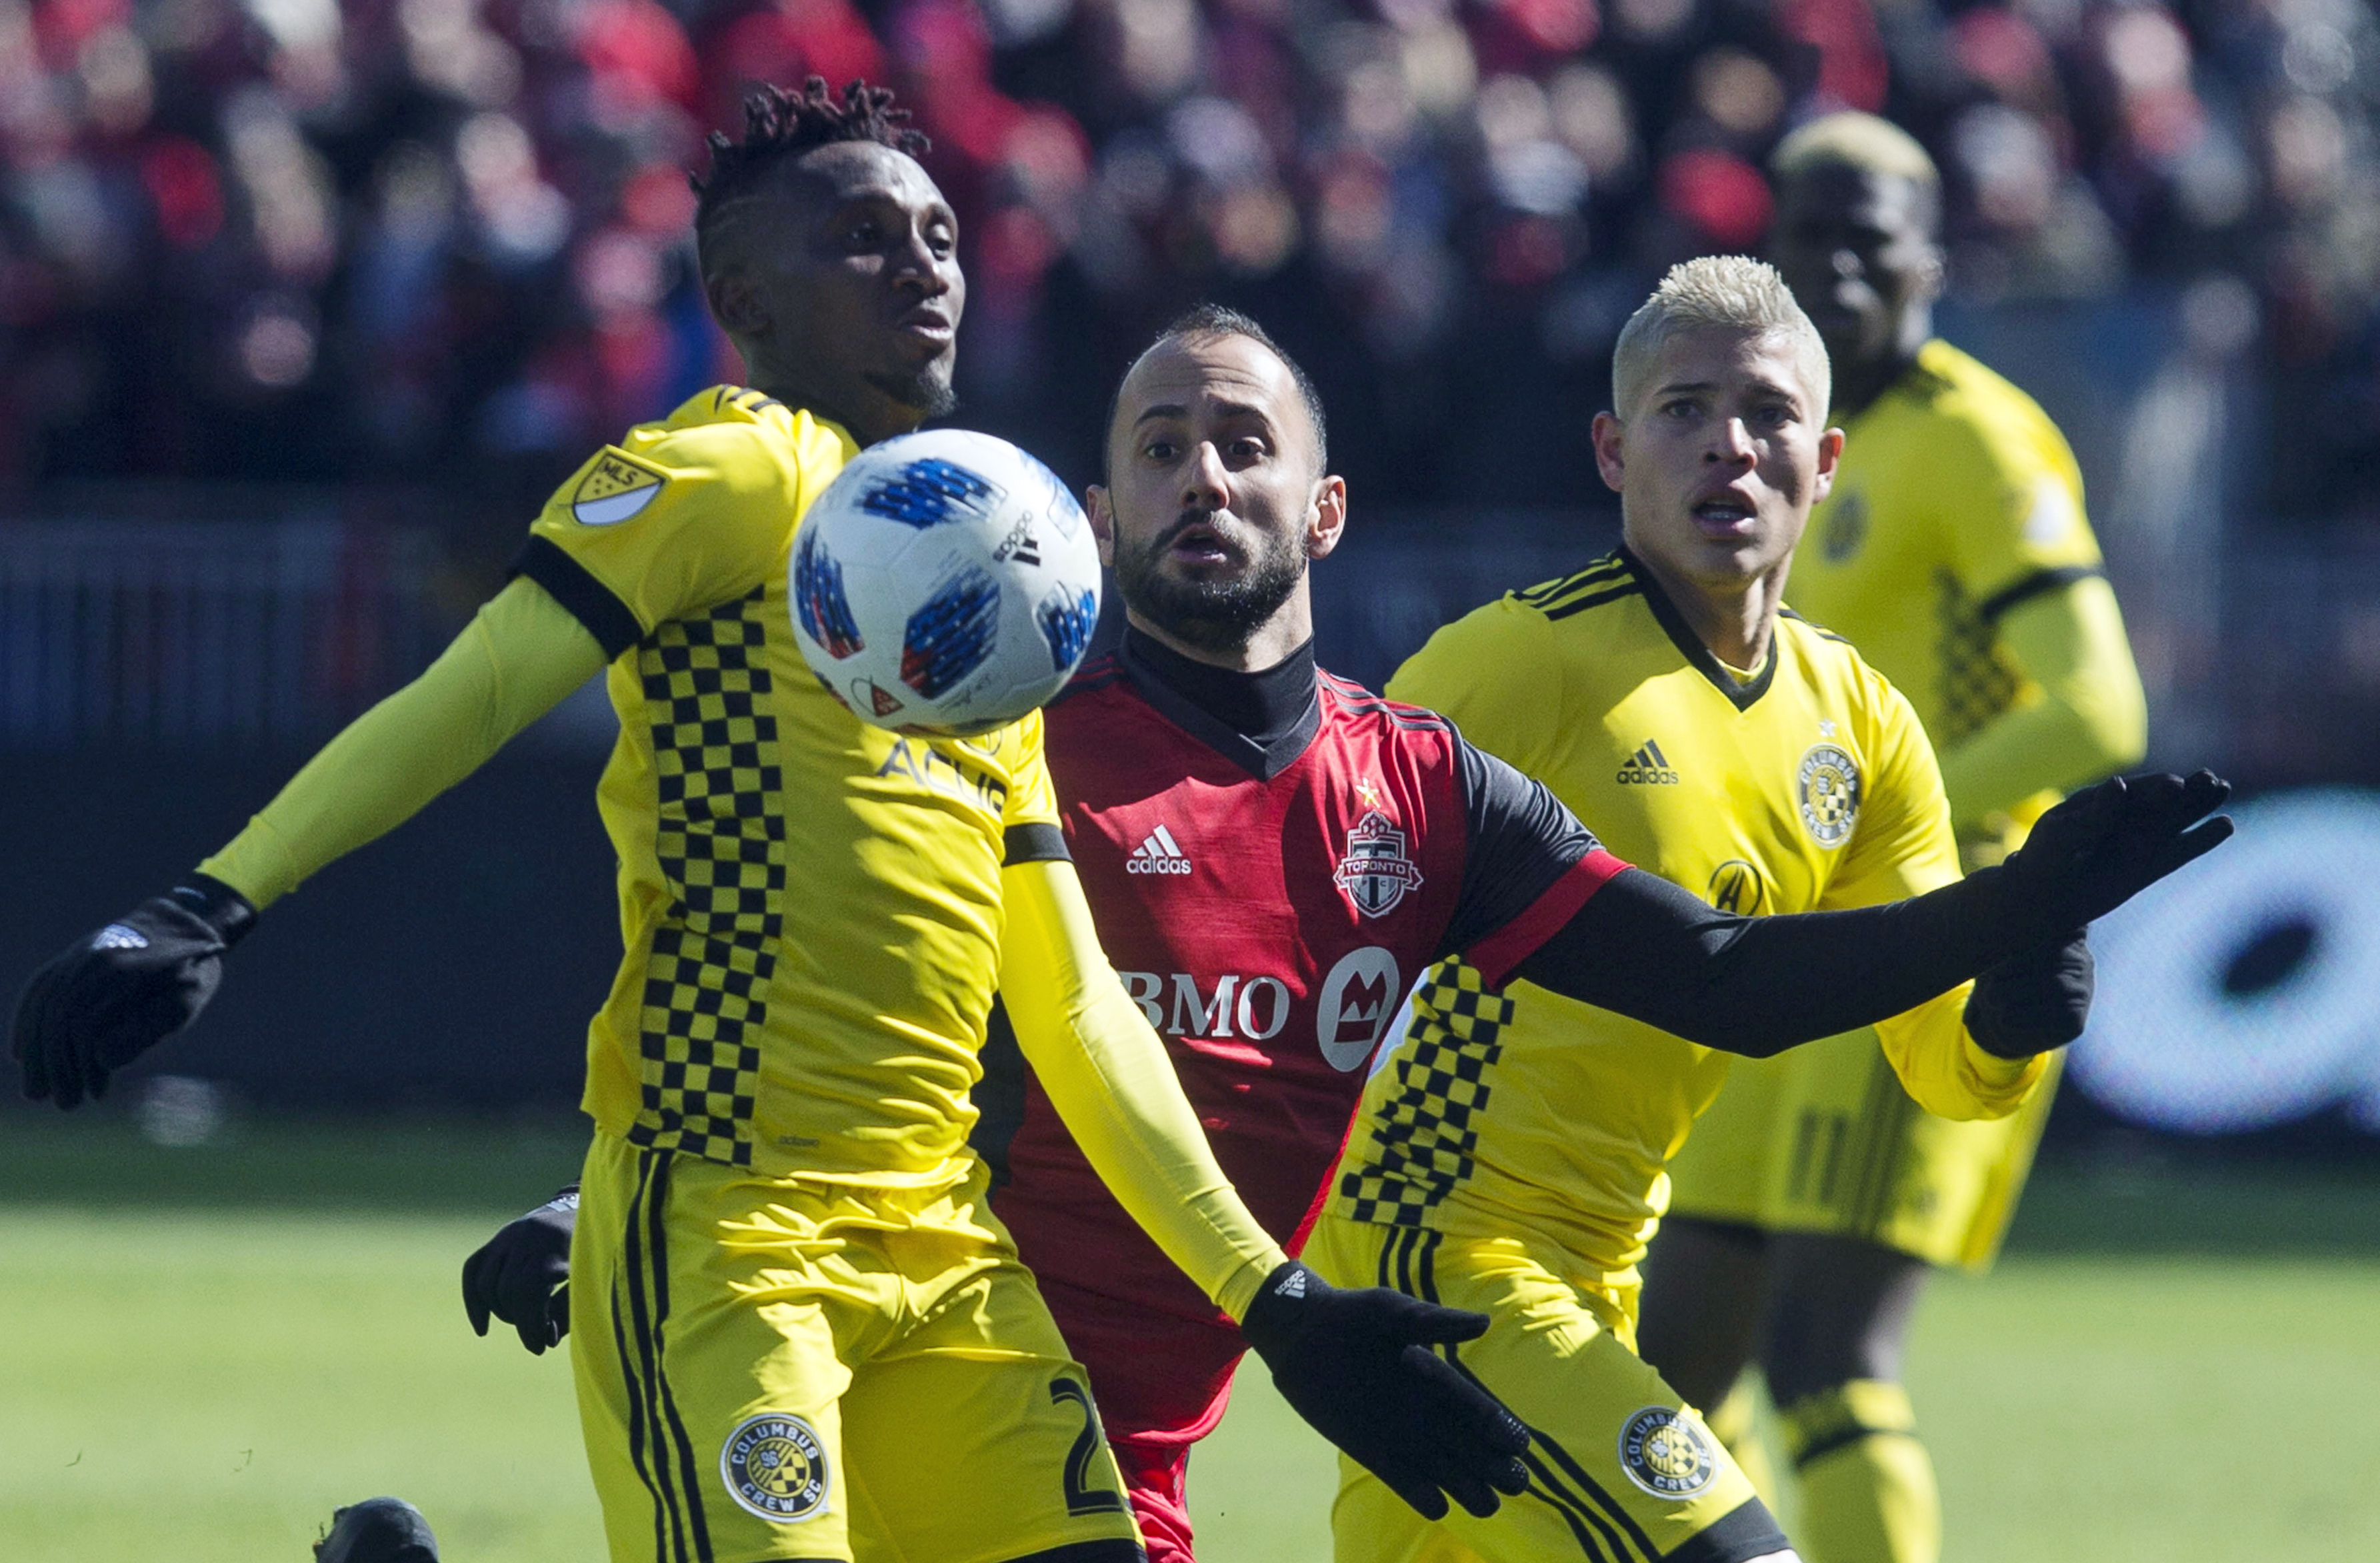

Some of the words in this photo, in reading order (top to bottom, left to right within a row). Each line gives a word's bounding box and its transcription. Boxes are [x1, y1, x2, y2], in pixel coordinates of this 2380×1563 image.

[601, 460, 637, 487] MLS
[1616, 767, 1679, 784] adidas
[1126, 856, 1192, 875] adidas
[1345, 860, 1406, 876] TORONTO
[1117, 970, 1290, 1040] BMO
[1273, 1269, 1305, 1296] adidas
[731, 1422, 819, 1465] COLUMBUS
[740, 1482, 795, 1512] CREW
[803, 1478, 822, 1504] SC
[1653, 1472, 1703, 1491] CREW
